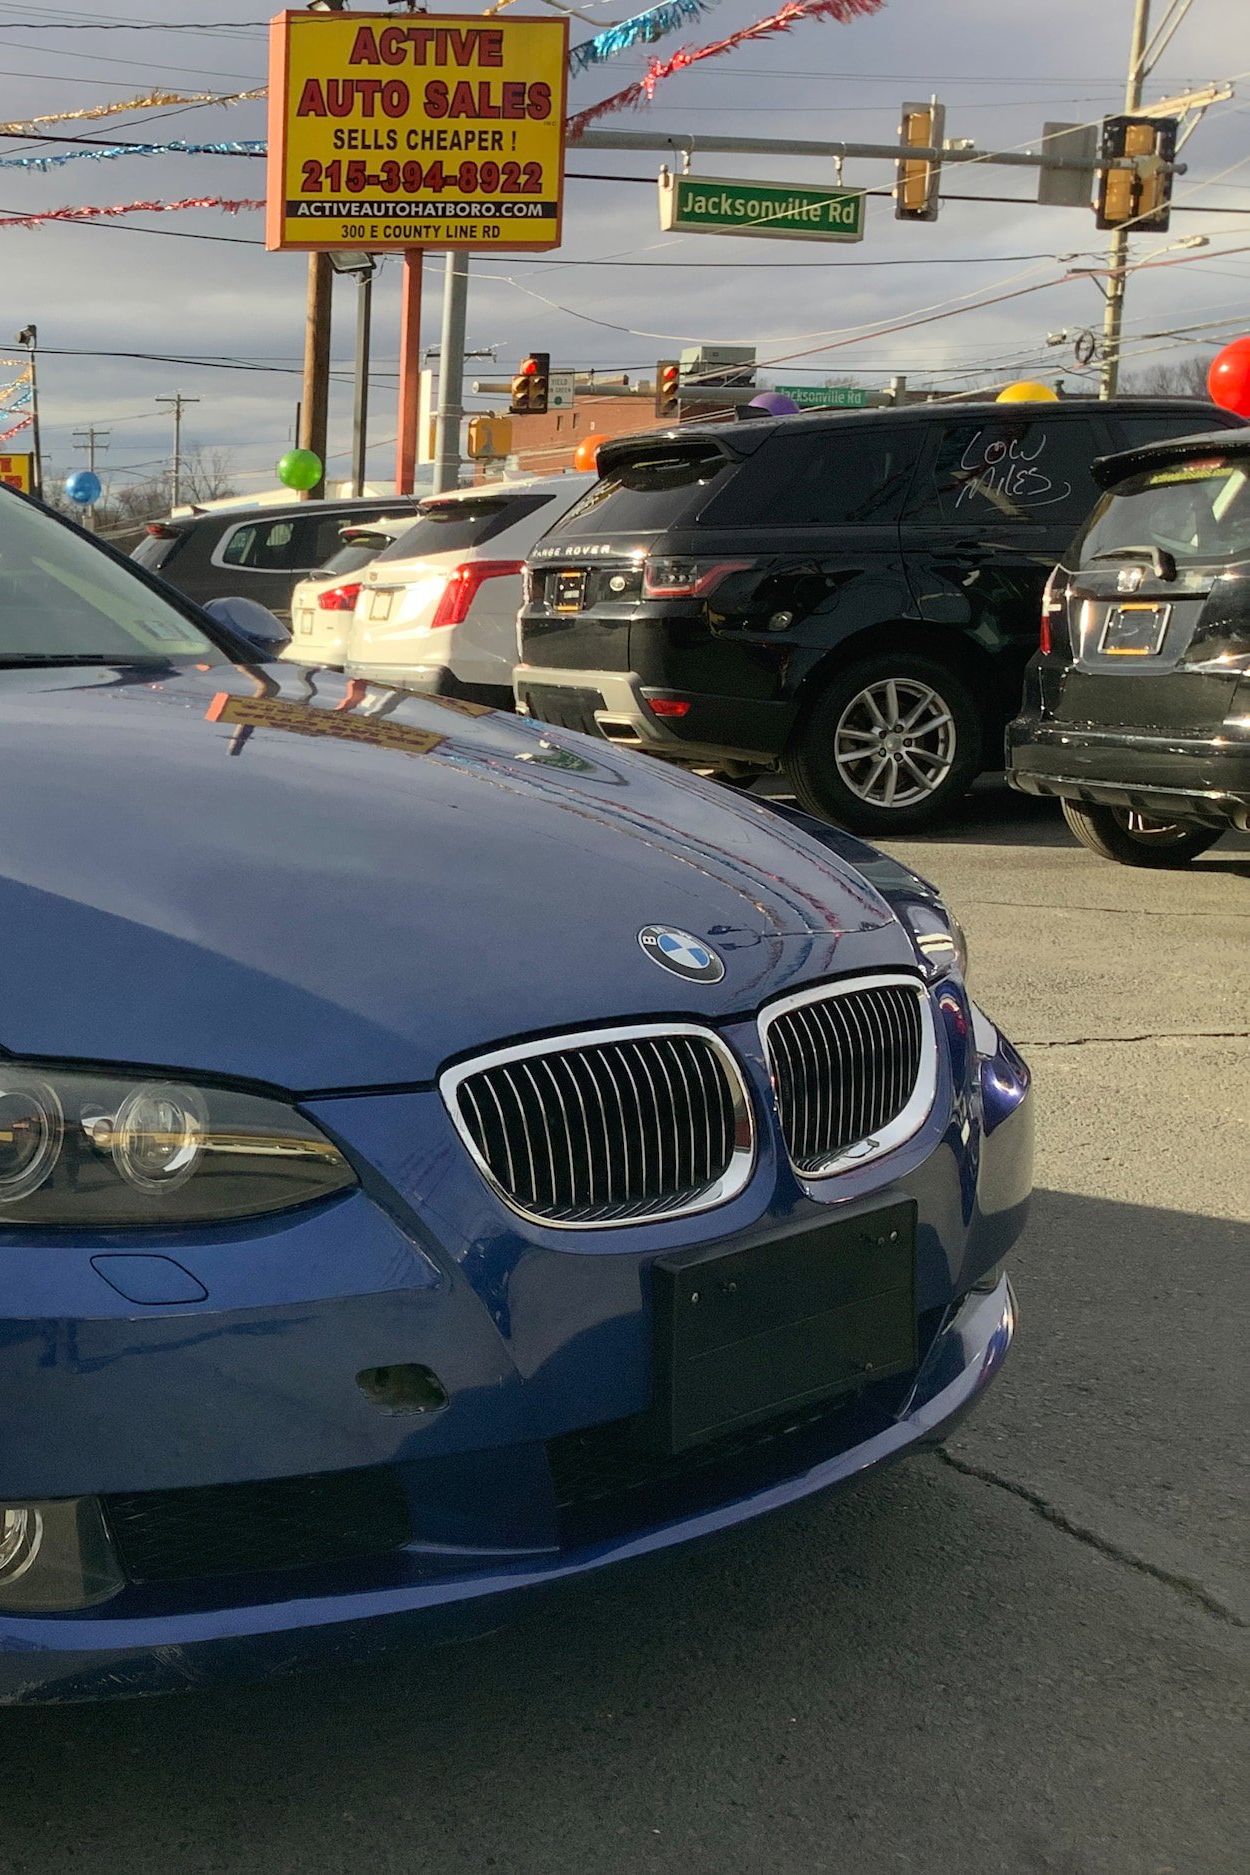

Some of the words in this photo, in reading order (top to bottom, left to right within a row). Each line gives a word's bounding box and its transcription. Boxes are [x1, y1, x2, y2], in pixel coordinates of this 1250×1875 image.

[349, 26, 504, 67] ACTIVE
[296, 79, 410, 118] AUTO
[423, 80, 552, 120] SALES
[333, 129, 398, 150] SELLS
[406, 129, 503, 151] CHEAPER
[301, 160, 543, 194] 215-394-8922
[297, 203, 543, 217] ACTIVEAUTOHATBORO.COM
[683, 192, 821, 222] Jacksonville
[828, 202, 855, 224] Rd
[341, 225, 367, 238] 300
[371, 225, 378, 238] E
[383, 225, 441, 239] COUNTY
[446, 225, 478, 239] LINE
[482, 225, 501, 239] RD
[847, 391, 862, 404] Rd
[961, 431, 1047, 470] LOW
[955, 464, 1052, 508] MILES
[565, 544, 610, 556] ROVER
